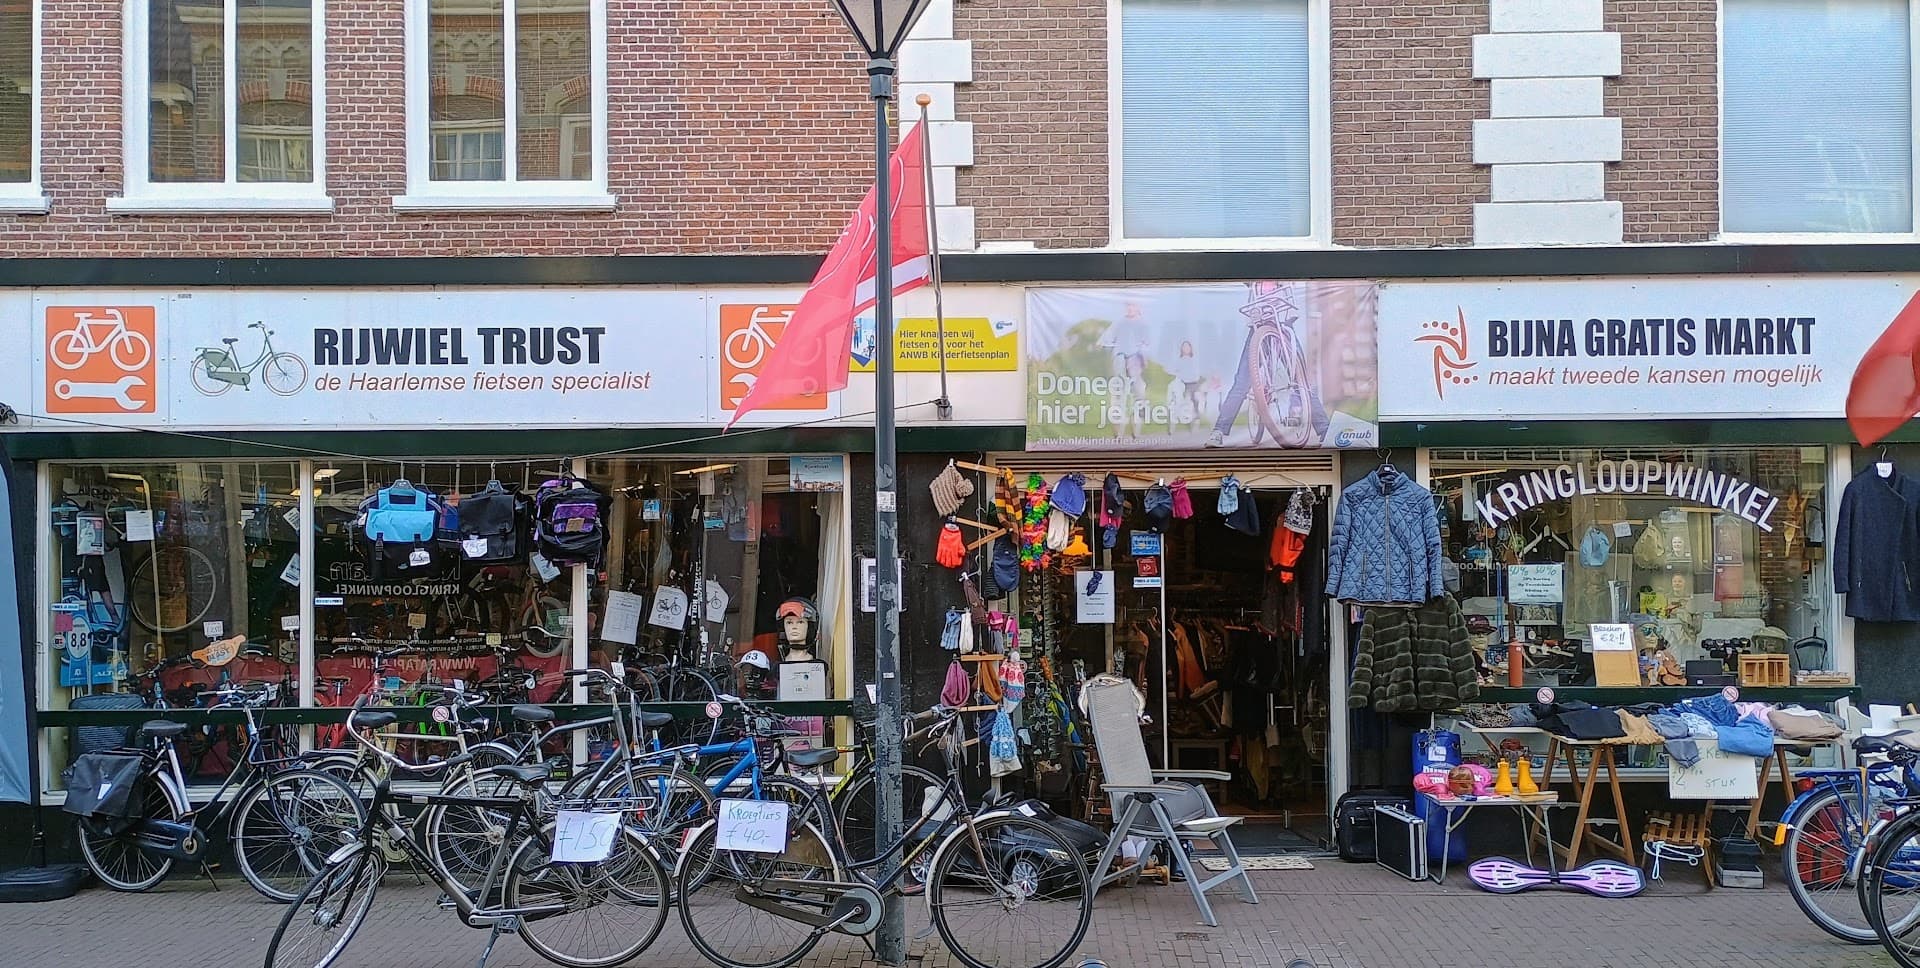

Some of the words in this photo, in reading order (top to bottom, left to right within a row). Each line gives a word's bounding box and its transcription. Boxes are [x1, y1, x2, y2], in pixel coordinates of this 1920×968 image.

[314, 327, 469, 366] RIJWIEL
[477, 326, 606, 366] TRUST
[899, 329, 918, 339] Hier
[961, 330, 975, 341] wij
[899, 340, 930, 350] fietsen
[946, 342, 967, 350] voor
[969, 340, 984, 349] het
[1488, 319, 1577, 358] BIJNA
[1584, 318, 1696, 357] GRATIS
[1705, 317, 1816, 356] MARKT
[899, 351, 929, 360] ANWB
[314, 372, 341, 392] de
[348, 372, 466, 392] Haarlemse
[473, 371, 544, 391] fietsen
[551, 370, 652, 395] specialist
[1036, 371, 1136, 396] Doneer
[1488, 367, 1556, 386] maakt
[1561, 366, 1640, 386] tweede
[1647, 366, 1726, 384] kansen
[1732, 364, 1823, 388] mogelijk
[1036, 400, 1091, 425] hier
[1097, 400, 1125, 429] je
[1134, 400, 1194, 425] fiets
[1341, 429, 1372, 439] anwb
[1474, 459, 1780, 533] KRINGLOOPWINKEL
[70, 632, 87, 651] 8,8
